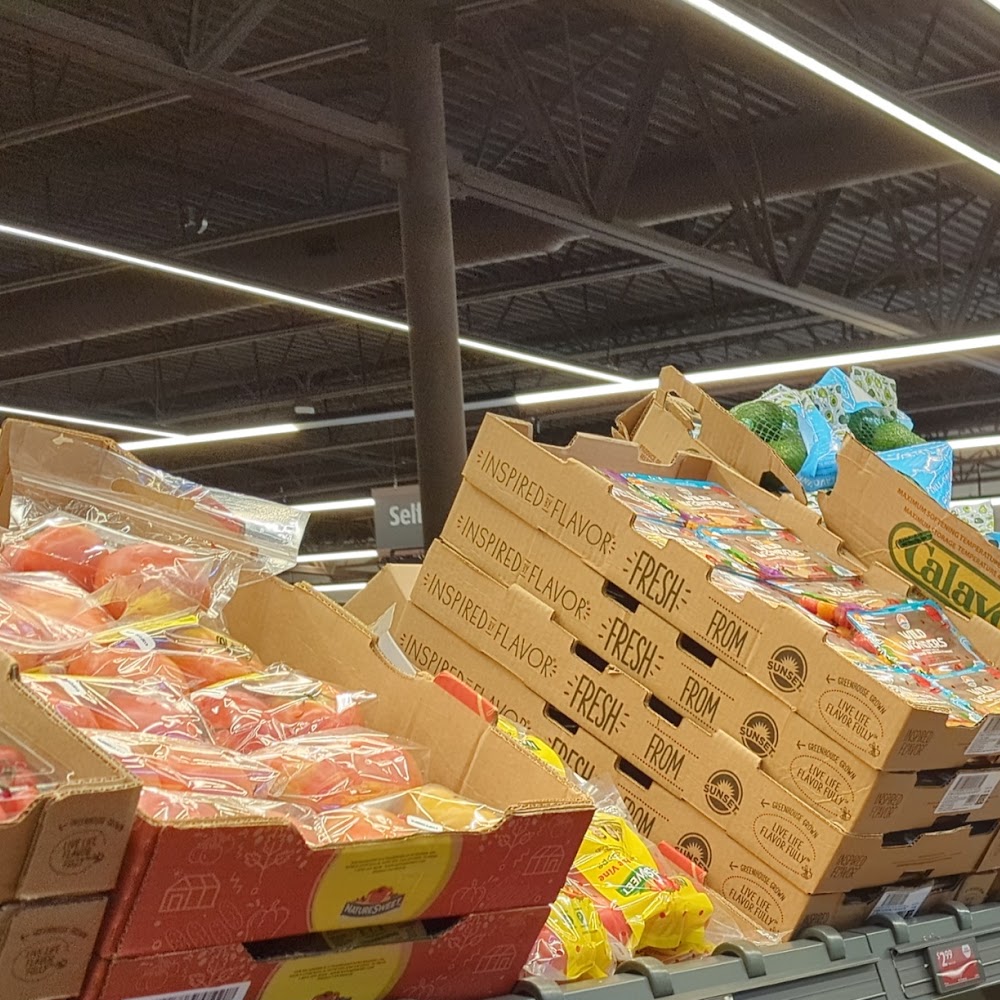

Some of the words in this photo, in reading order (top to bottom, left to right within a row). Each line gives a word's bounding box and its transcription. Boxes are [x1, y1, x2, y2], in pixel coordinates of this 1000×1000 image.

[480, 450, 544, 507] INSPIRED
[550, 499, 613, 555] FLAVOR
[897, 488, 927, 515] MAXIMUM
[926, 509, 961, 540] SOFTENING
[904, 506, 933, 533] MAXIMUM
[460, 515, 523, 572] INSPIRED
[527, 563, 588, 619] FLAVOR
[627, 549, 685, 613] FRESH
[427, 573, 488, 630] INSPIRED
[493, 622, 555, 677] FLAVOR
[706, 609, 749, 658] FROM
[604, 616, 658, 679] FRESH
[767, 659, 805, 692] SUNSET
[569, 673, 624, 736] FRESH
[679, 675, 722, 724] FROM
[837, 676, 868, 701] GREENHOUSE
[868, 693, 888, 716] GROWN
[837, 698, 856, 717] LIVE
[854, 709, 869, 727] LIFE
[739, 725, 776, 757] SUNSET
[825, 703, 853, 728] FLAVOR
[851, 720, 875, 742] FULLY
[644, 732, 687, 781] FROM
[808, 742, 838, 766] GREENHOUSE
[838, 760, 857, 781] GROWN
[796, 769, 824, 793] FLAVOR
[821, 785, 845, 806] FULLY
[808, 763, 826, 782] LIVE
[824, 775, 841, 793] LIFE
[703, 783, 740, 815] SUNSET
[771, 801, 802, 824] GREENHOUSE
[801, 817, 820, 840] GROWN
[771, 822, 789, 841] LIVE
[787, 833, 804, 851] LIFE
[759, 825, 787, 851] FLAVOR
[785, 844, 808, 866] FULLY
[599, 865, 620, 883] Vine
[740, 863, 770, 887] GREENHOUSE
[769, 881, 787, 903] GROWN
[728, 888, 756, 914] FLAVOR
[753, 906, 776, 927] FULLY
[740, 884, 757, 903] LIVE
[755, 896, 771, 914] LIFE
